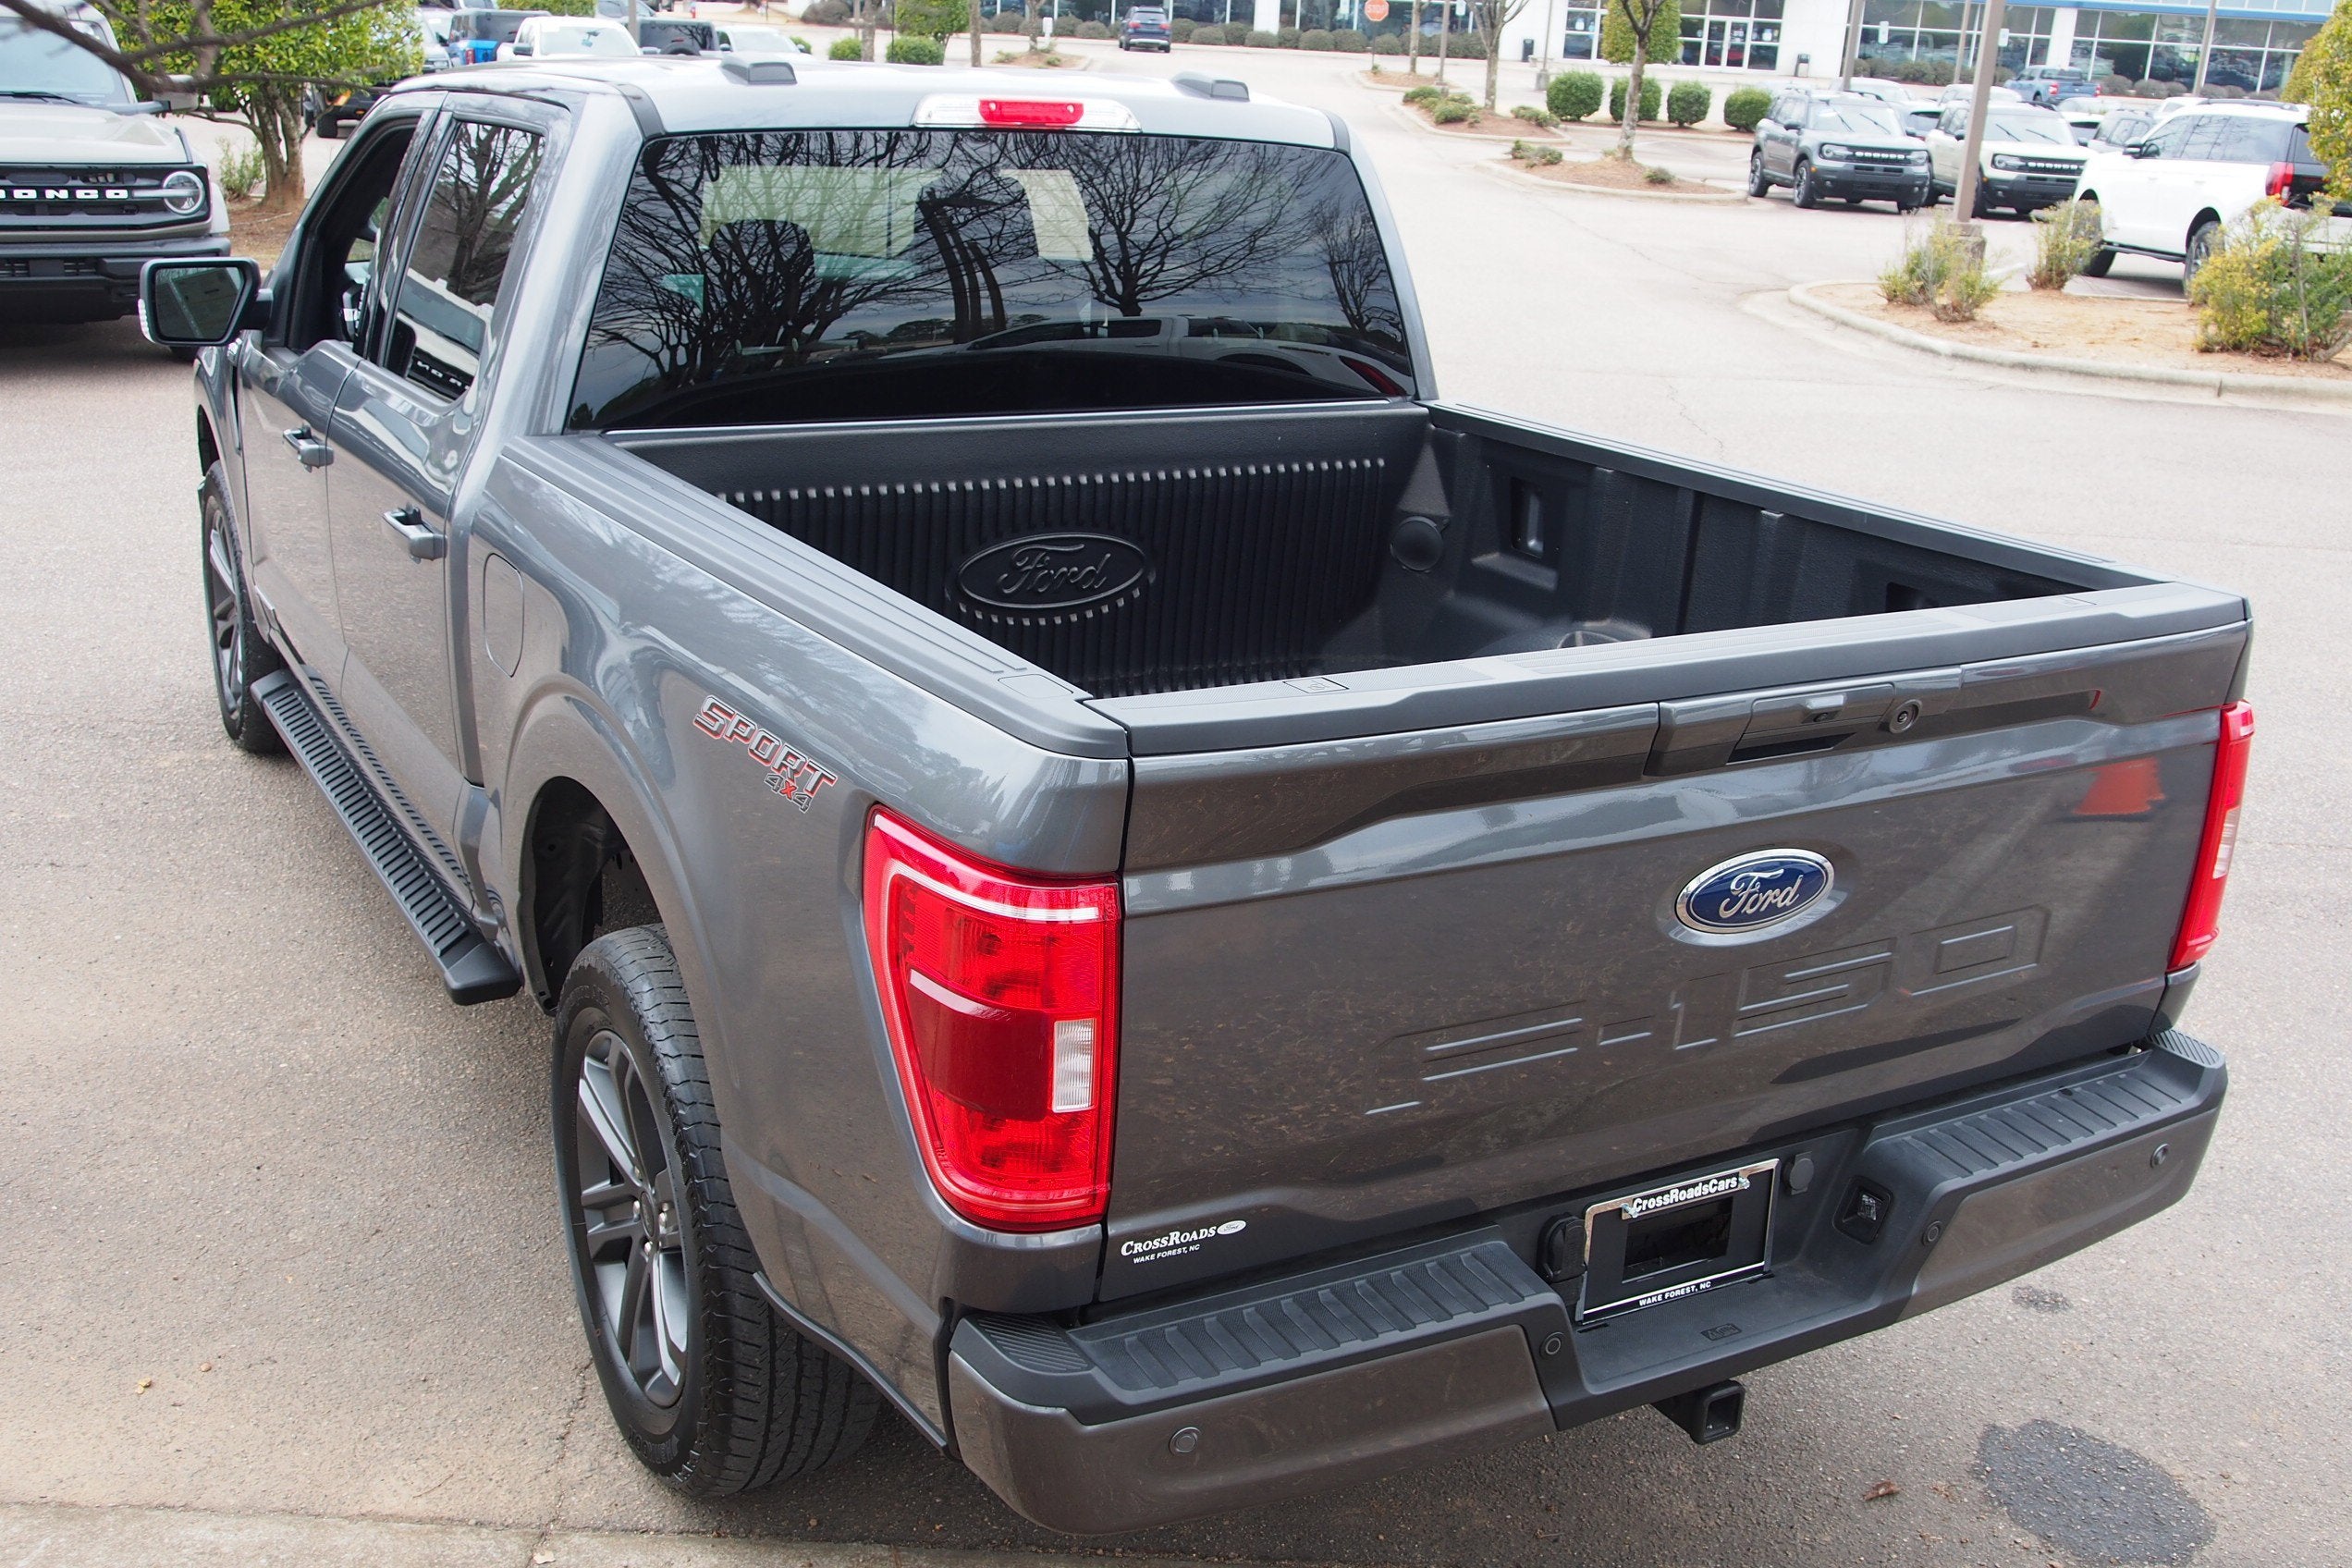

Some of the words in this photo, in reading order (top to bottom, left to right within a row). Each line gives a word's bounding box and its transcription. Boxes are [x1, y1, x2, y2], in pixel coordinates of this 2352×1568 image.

[0, 189, 129, 199] ONCO
[997, 544, 1111, 594] Ford
[692, 694, 839, 797] SPORT
[1718, 868, 1804, 919] Ford
[1631, 1175, 1739, 1213] CrossRoadsCars
[1133, 1253, 1156, 1265] WAKE
[1157, 1246, 1188, 1259] FOREST,
[1189, 1243, 1201, 1252] NC
[1638, 1293, 1663, 1306] WAKE
[1664, 1285, 1697, 1301] FOREST,
[1699, 1280, 1711, 1291] NC
